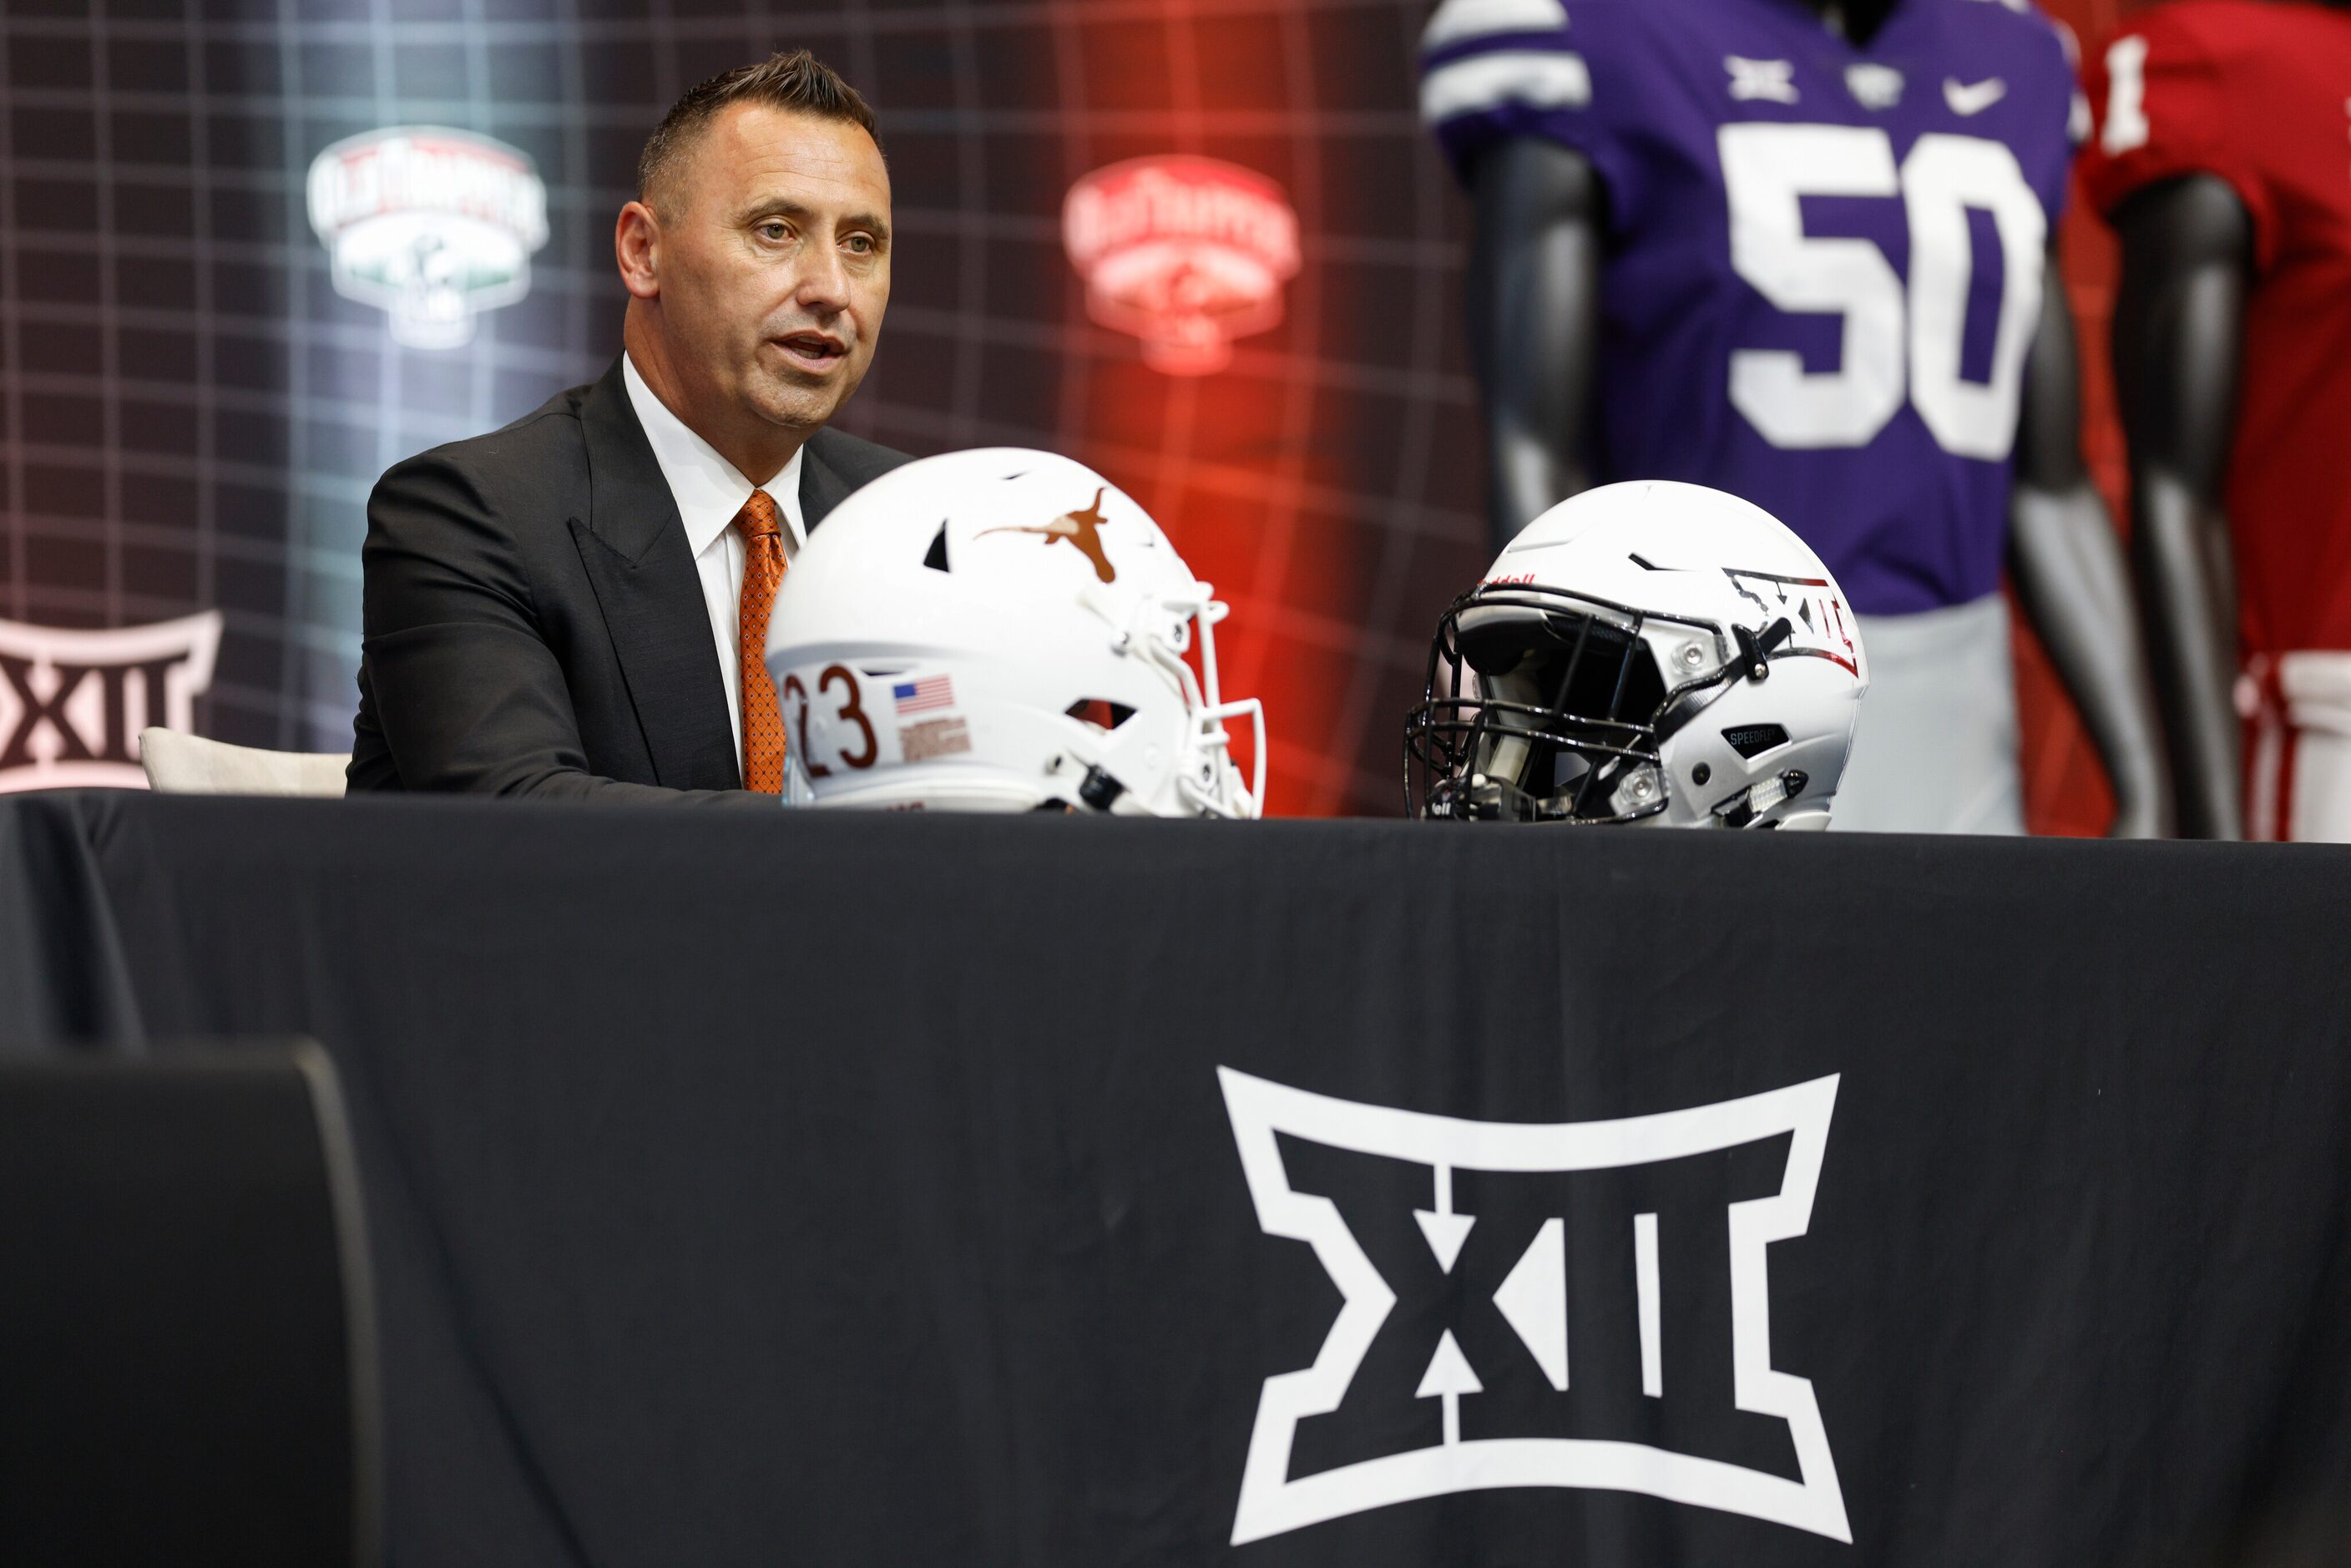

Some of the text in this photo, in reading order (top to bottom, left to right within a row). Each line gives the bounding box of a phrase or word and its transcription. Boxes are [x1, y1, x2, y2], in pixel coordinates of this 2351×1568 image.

[1717, 121, 2047, 462] 50
[785, 662, 878, 780] 23
[1272, 1127, 1807, 1488] XII
